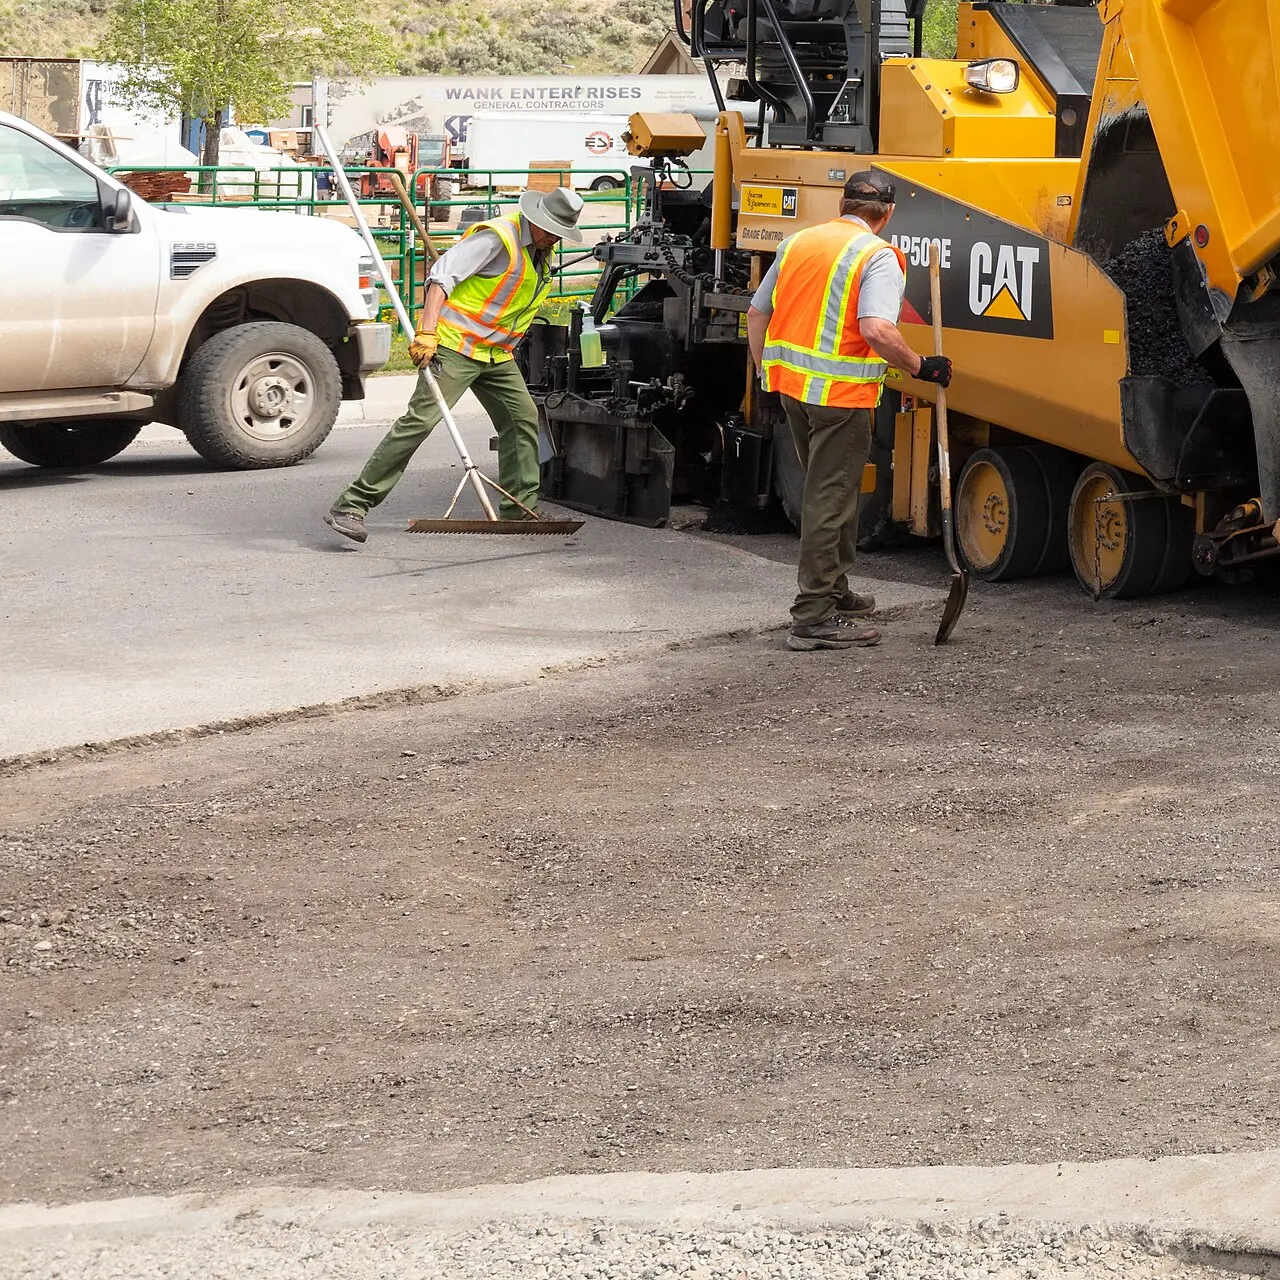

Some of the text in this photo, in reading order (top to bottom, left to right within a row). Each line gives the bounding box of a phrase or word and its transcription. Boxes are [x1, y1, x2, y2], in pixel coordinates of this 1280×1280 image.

[445, 87, 503, 100] WANK
[510, 87, 642, 100] ENTERPRISES
[473, 100, 604, 109] GENERAL CONTRACTORS
[783, 195, 796, 209] CAT
[742, 227, 784, 241] GRADE CONTROL
[969, 241, 1040, 321] CAT
